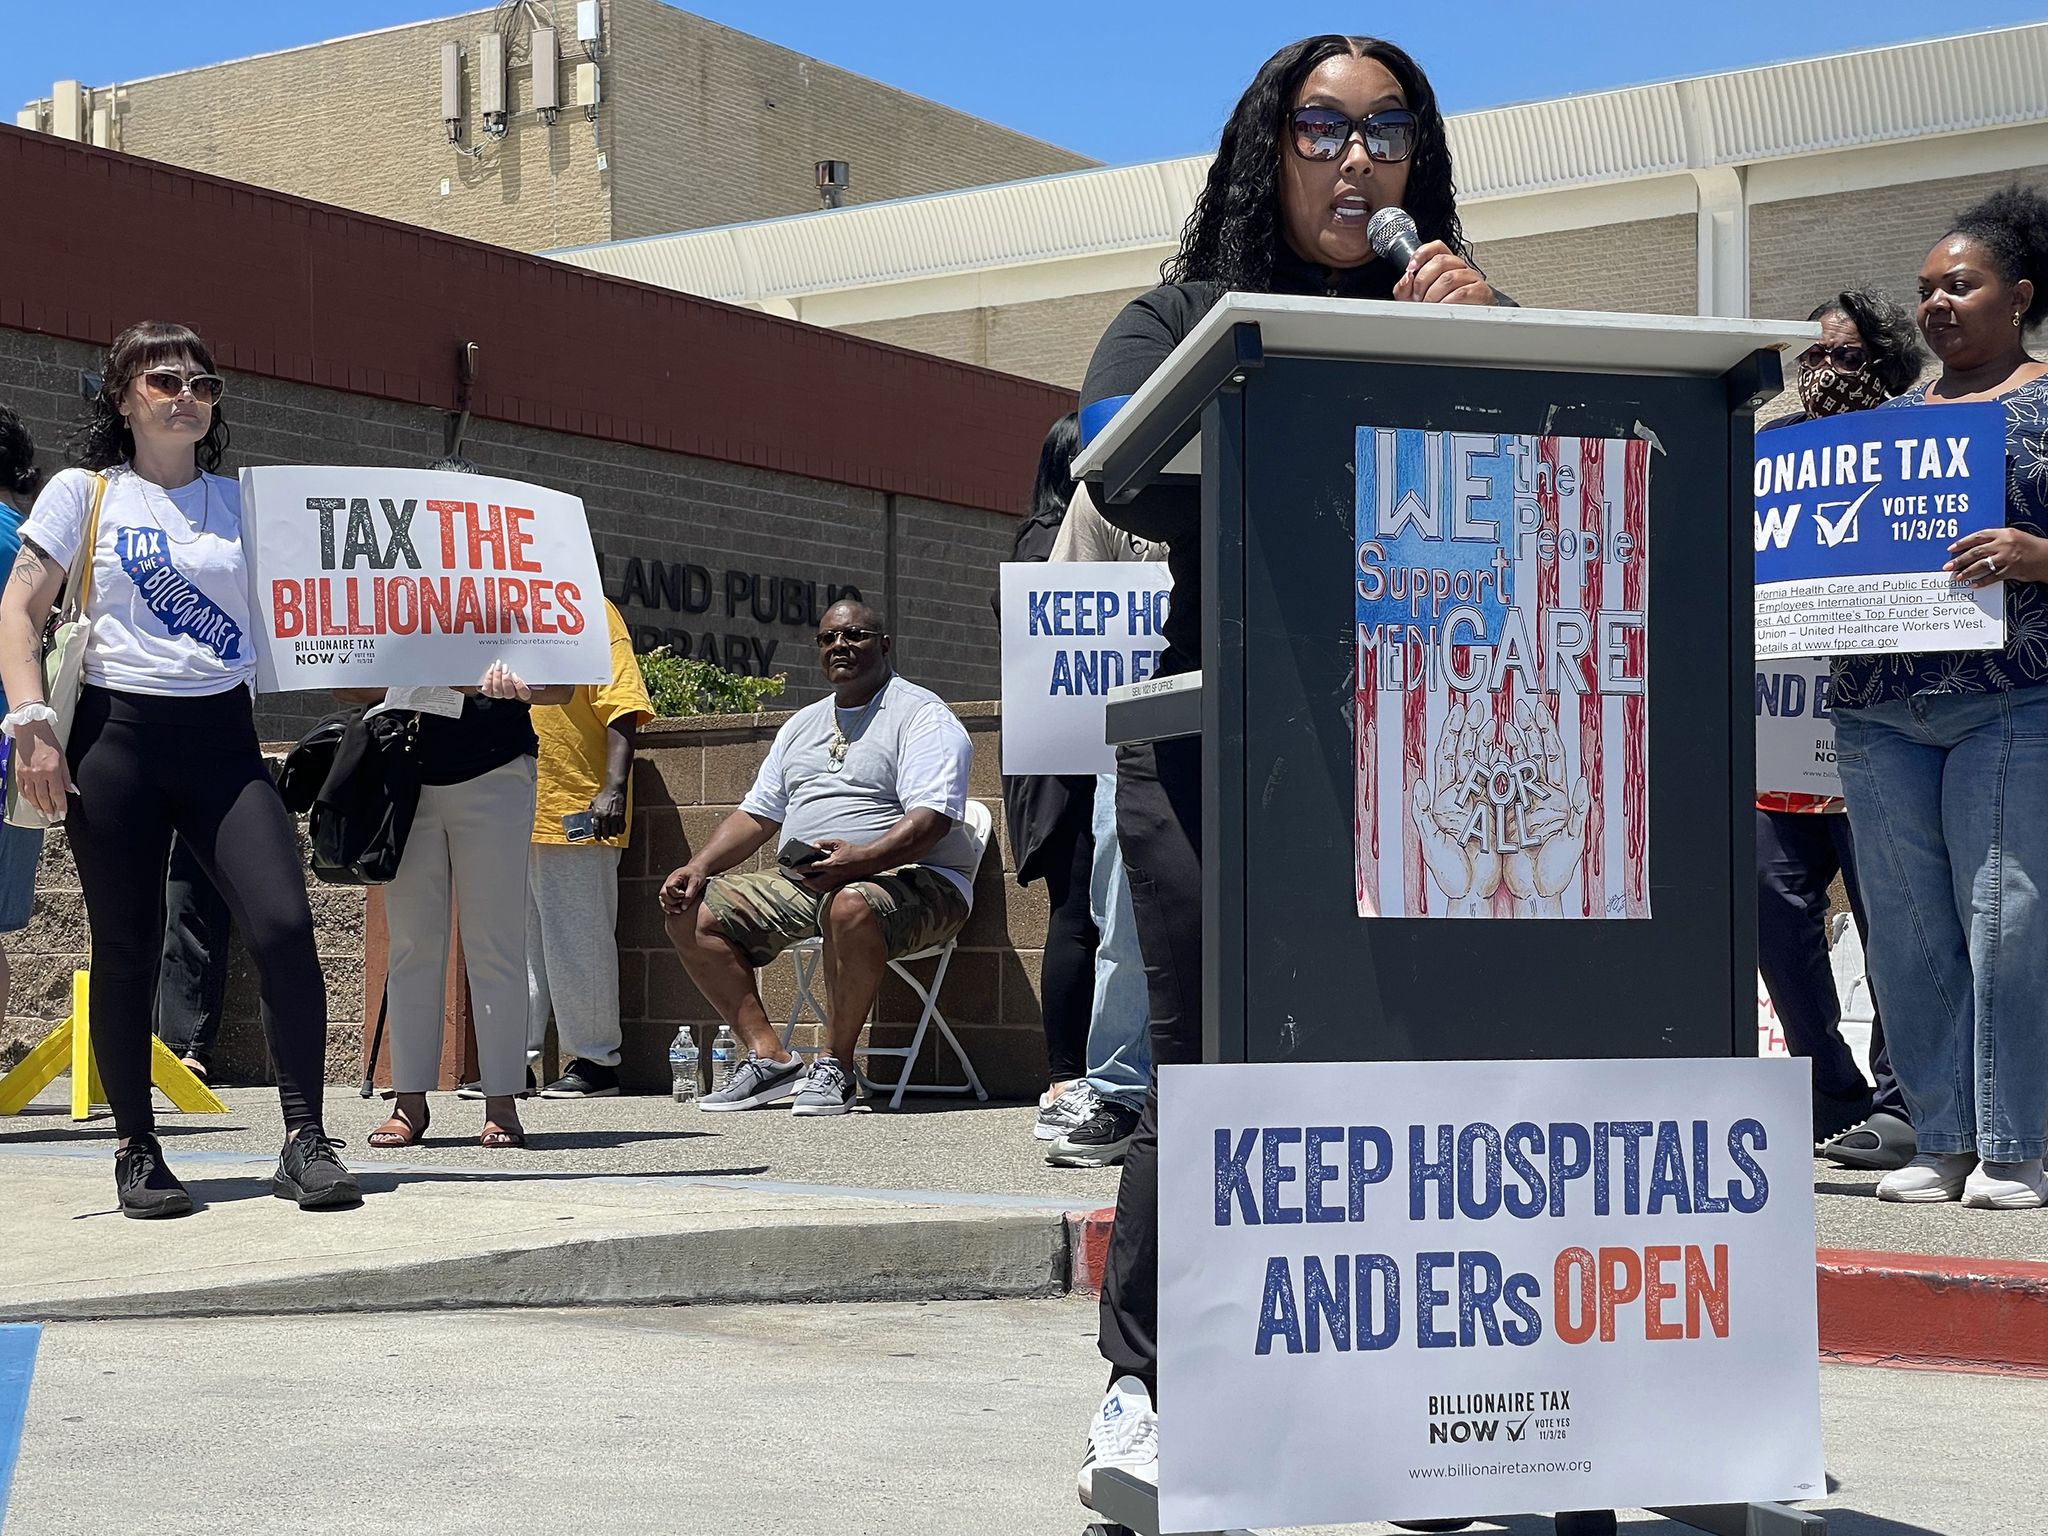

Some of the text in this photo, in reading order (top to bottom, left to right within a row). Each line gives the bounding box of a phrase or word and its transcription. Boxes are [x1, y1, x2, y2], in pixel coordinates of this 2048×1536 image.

[1754, 436, 1970, 497] ONAIRE TAX
[1374, 428, 1575, 544] WE the
[1882, 493, 1969, 518] VOTE YES
[124, 528, 161, 560] TAX
[306, 497, 543, 573] TAX THE
[1513, 499, 1636, 587] People
[1891, 518, 1958, 542] 11/3/26
[138, 556, 159, 573] THE
[1357, 542, 1511, 617] Support
[597, 553, 863, 627] LAND PUBL
[1755, 588, 1787, 599] lifornia
[1790, 585, 1824, 596] Health
[1828, 583, 1854, 593] Care
[1858, 581, 1879, 591] and
[1883, 579, 1917, 590] Public
[1758, 599, 1814, 613] Employees
[1817, 594, 1886, 607] International
[1890, 594, 1923, 605] Union
[1937, 591, 1975, 603] United
[143, 566, 236, 656] BILLIONAIRES
[272, 576, 585, 639] BILLIONAIRES
[1028, 591, 1120, 636] KEEP
[1776, 614, 1791, 625] Ad
[1794, 609, 1861, 623] Committee's
[1865, 609, 1885, 620] Top
[1888, 607, 1929, 618] Funder
[1932, 606, 1976, 617] Service
[295, 639, 375, 652] BILLIONAIRE TAX
[478, 638, 579, 646] www.billionairetaxnow.org
[1755, 637, 1898, 653] Details at www.fppc.ca.gov
[1757, 629, 1787, 640] Union
[1799, 625, 1835, 636] United
[1838, 623, 1899, 634] Healthcare
[1902, 620, 1950, 631] Workers
[1954, 619, 1986, 630] West.
[295, 652, 335, 666] NOW
[629, 624, 779, 678] BRARY
[1358, 606, 1646, 696] MEDICARE
[1049, 650, 1124, 697] AND
[1756, 673, 1806, 718] ND
[1815, 751, 1837, 763] NO
[1454, 758, 1551, 810] FOR
[1458, 801, 1542, 855] ALL
[1214, 1117, 1769, 1226] KEEP HOSPITALS
[1254, 1243, 1729, 1356] AND ERs OPEN
[1429, 1390, 1570, 1416] BILLIONAIRE TAX
[1429, 1420, 1499, 1444] NOW
[1535, 1417, 1570, 1429] VOTE YES
[1539, 1429, 1566, 1440] 11/3/26
[1408, 1459, 1592, 1480] www.billionairetaxnow.org
